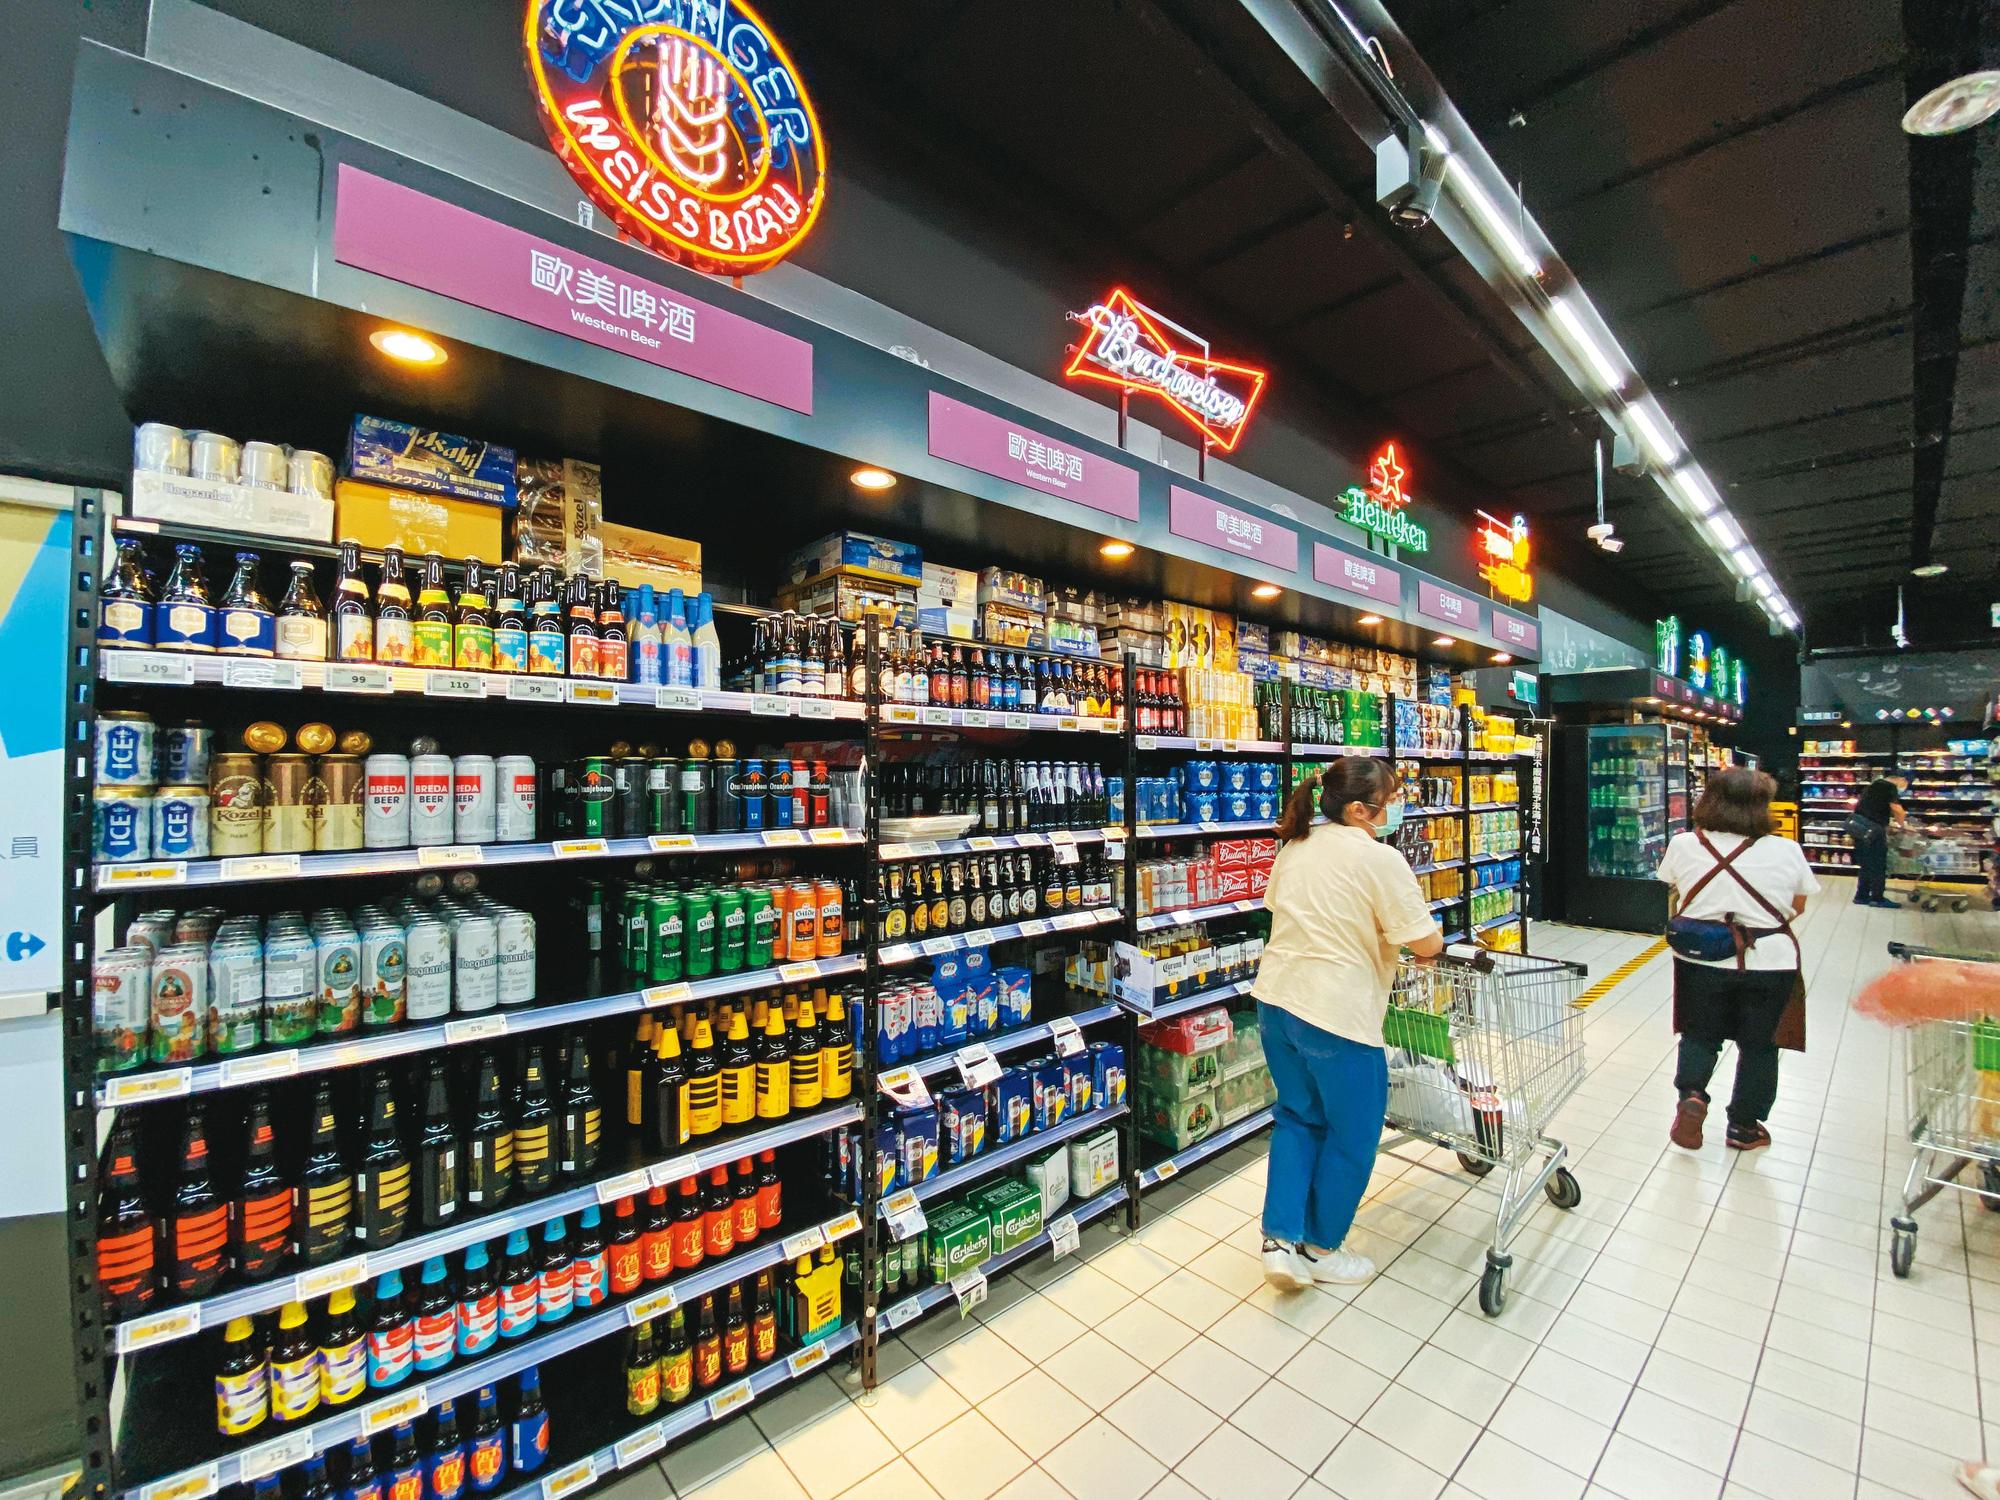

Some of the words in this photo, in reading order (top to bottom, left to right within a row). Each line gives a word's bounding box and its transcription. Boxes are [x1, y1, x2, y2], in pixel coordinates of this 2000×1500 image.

[530, 249, 696, 344] 歐美啤酒
[571, 308, 628, 338] Western
[630, 328, 662, 350] Beer
[1088, 304, 1247, 422] Budweiser
[416, 431, 477, 471] Asahi
[1007, 431, 1083, 483] 歐美啤酒
[573, 498, 588, 540] Kozel
[1216, 510, 1262, 545] 歐美啤酒
[1347, 486, 1429, 553] Heineken
[143, 664, 168, 674] 109
[351, 675, 366, 684] 99
[450, 681, 470, 689] 110
[111, 738, 134, 769] ICE
[369, 785, 404, 794] BREDA
[373, 795, 400, 804] BEER
[415, 784, 448, 793] BREDA
[419, 795, 444, 803] BEER
[515, 784, 535, 792] BRED
[110, 814, 131, 846] ICE
[168, 812, 188, 844] ICE
[216, 809, 260, 823] Kozel
[1005, 1209, 1041, 1236] Carlsberg
[950, 1234, 988, 1263] Carlsberg
[387, 1403, 408, 1416] 109
